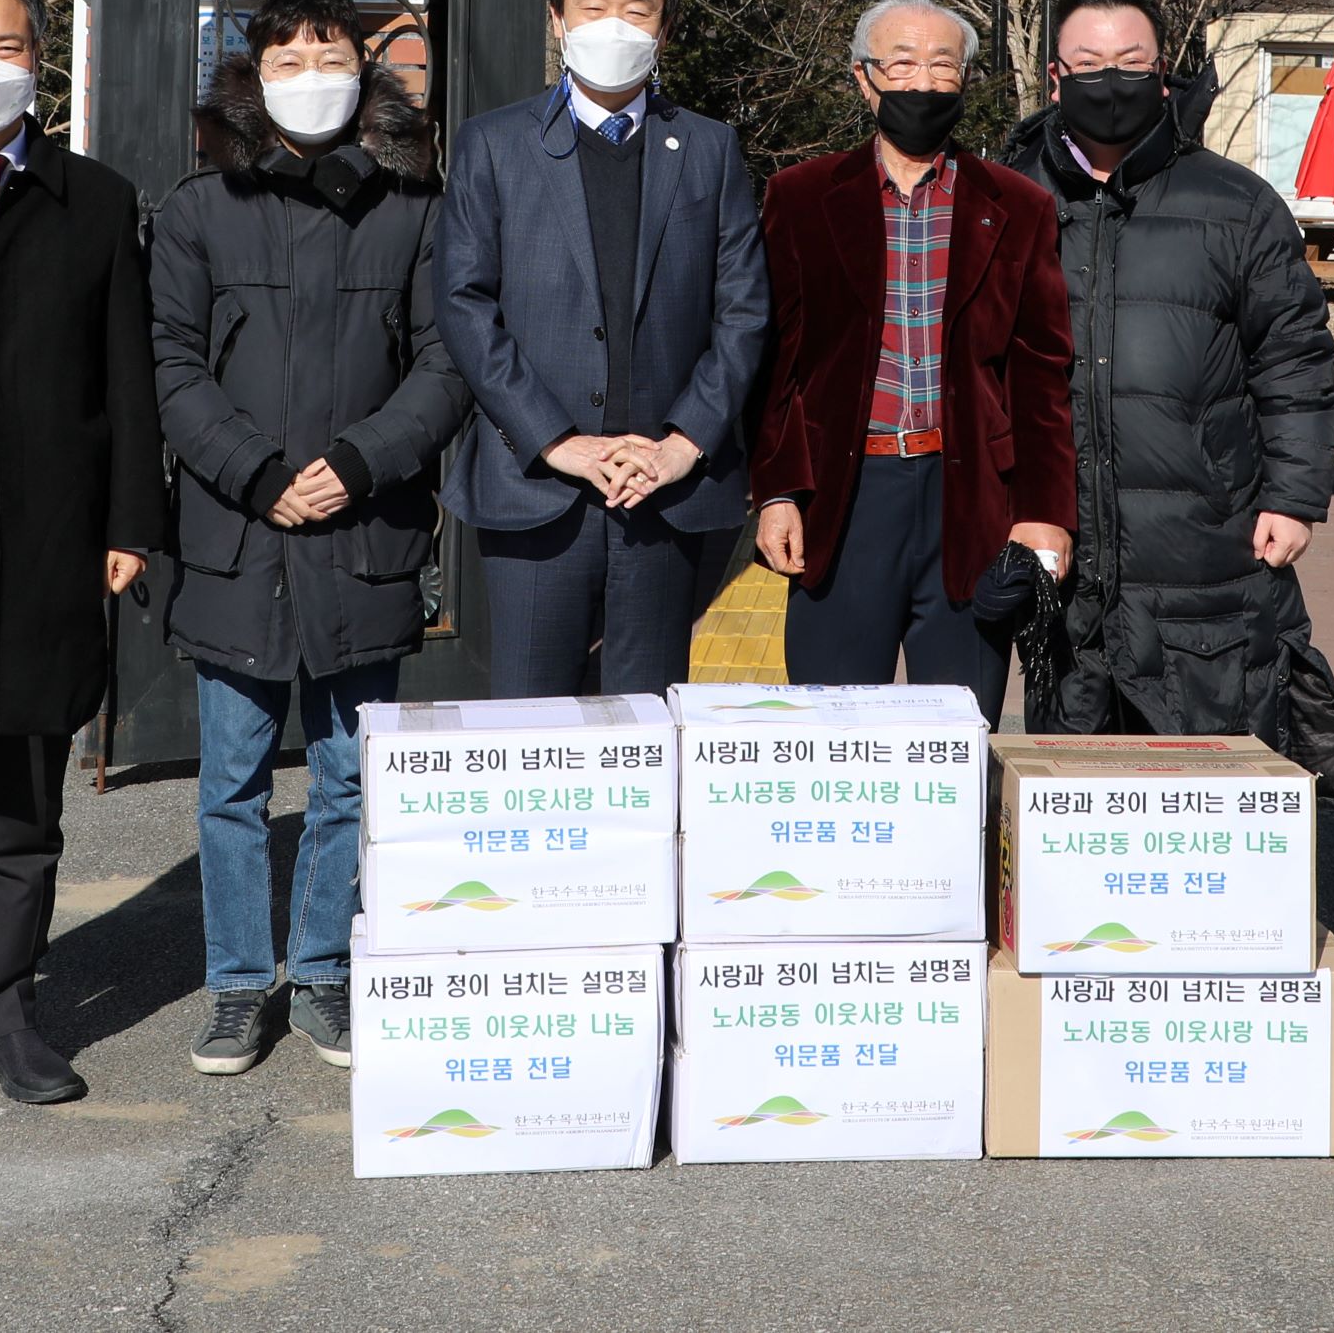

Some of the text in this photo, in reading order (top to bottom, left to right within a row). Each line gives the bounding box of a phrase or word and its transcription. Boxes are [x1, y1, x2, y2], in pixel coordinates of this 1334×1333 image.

[386, 745, 662, 774] 사랑과 정이 넘치는 설명절
[695, 741, 969, 764] 사랑과 정이 넘치는 설명절
[400, 786, 650, 814] 노사공동 이웃사랑 나눔
[709, 781, 956, 804] 노사공동 이웃사랑 나눔
[1028, 791, 1300, 814] 사랑과 정이 넘치는 설명절
[464, 828, 588, 852] 위문품 전달
[771, 821, 895, 843] 위문품 전달
[1043, 832, 1287, 855] 노사공동 이웃사랑 나눔
[1104, 872, 1226, 894] 위문품 전달
[367, 970, 645, 999] 사랑과 정이 넘치는 설명절
[700, 959, 970, 988] 사랑과 정이 넘치는 설명절
[1050, 981, 1322, 1003] 사랑과 정이 넘치는 설명절
[713, 1002, 959, 1027] 노사공동 이웃사랑 나눔
[382, 1013, 634, 1040] 노사공동 이웃사랑 나눔
[1064, 1021, 1308, 1043] 노사공동 이웃사랑 나눔
[775, 1044, 898, 1067] 위문품 전달
[446, 1056, 571, 1082] 위문품 전달
[1125, 1061, 1247, 1083] 위문품 전달
